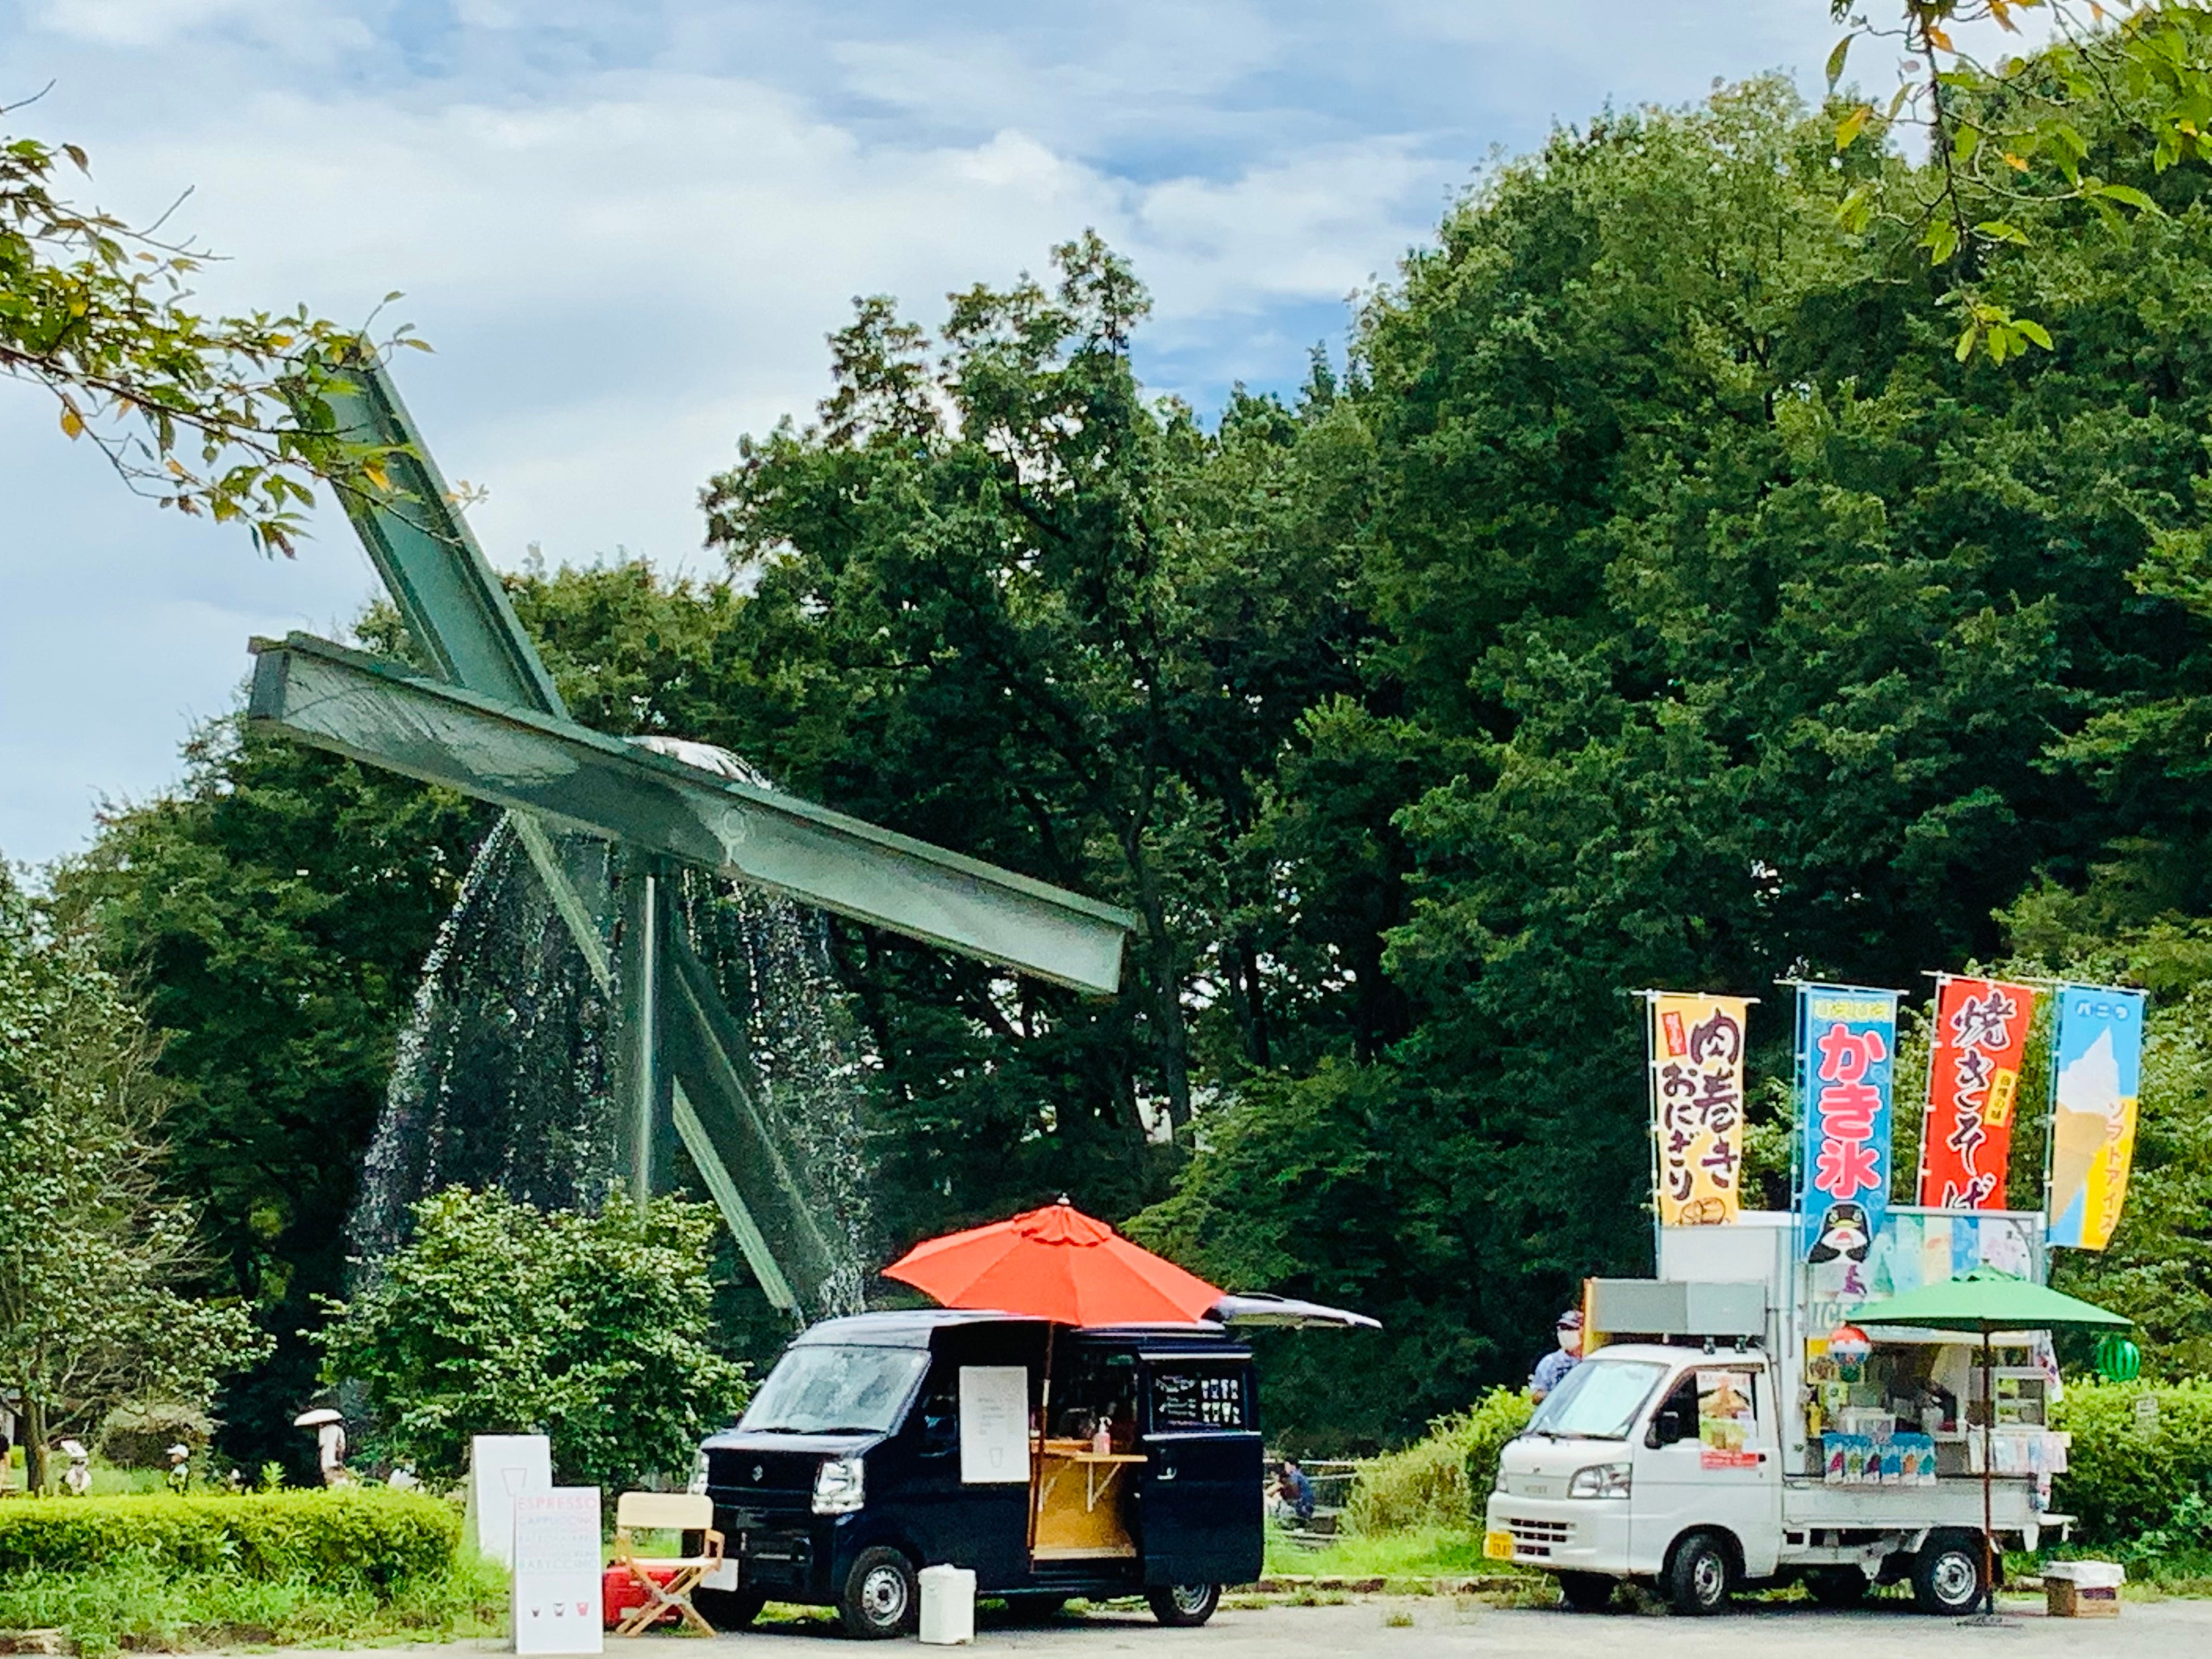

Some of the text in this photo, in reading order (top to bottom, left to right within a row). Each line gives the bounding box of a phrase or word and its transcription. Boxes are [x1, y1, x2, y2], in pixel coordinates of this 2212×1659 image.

[1662, 1062, 1700, 1201] おにぎり
[1690, 1007, 1740, 1188] 肉巻き
[1816, 1023, 1886, 1198] かき氷
[2100, 1102, 2125, 1231] ソフトアイス
[518, 1496, 598, 1510] ESPRESSO
